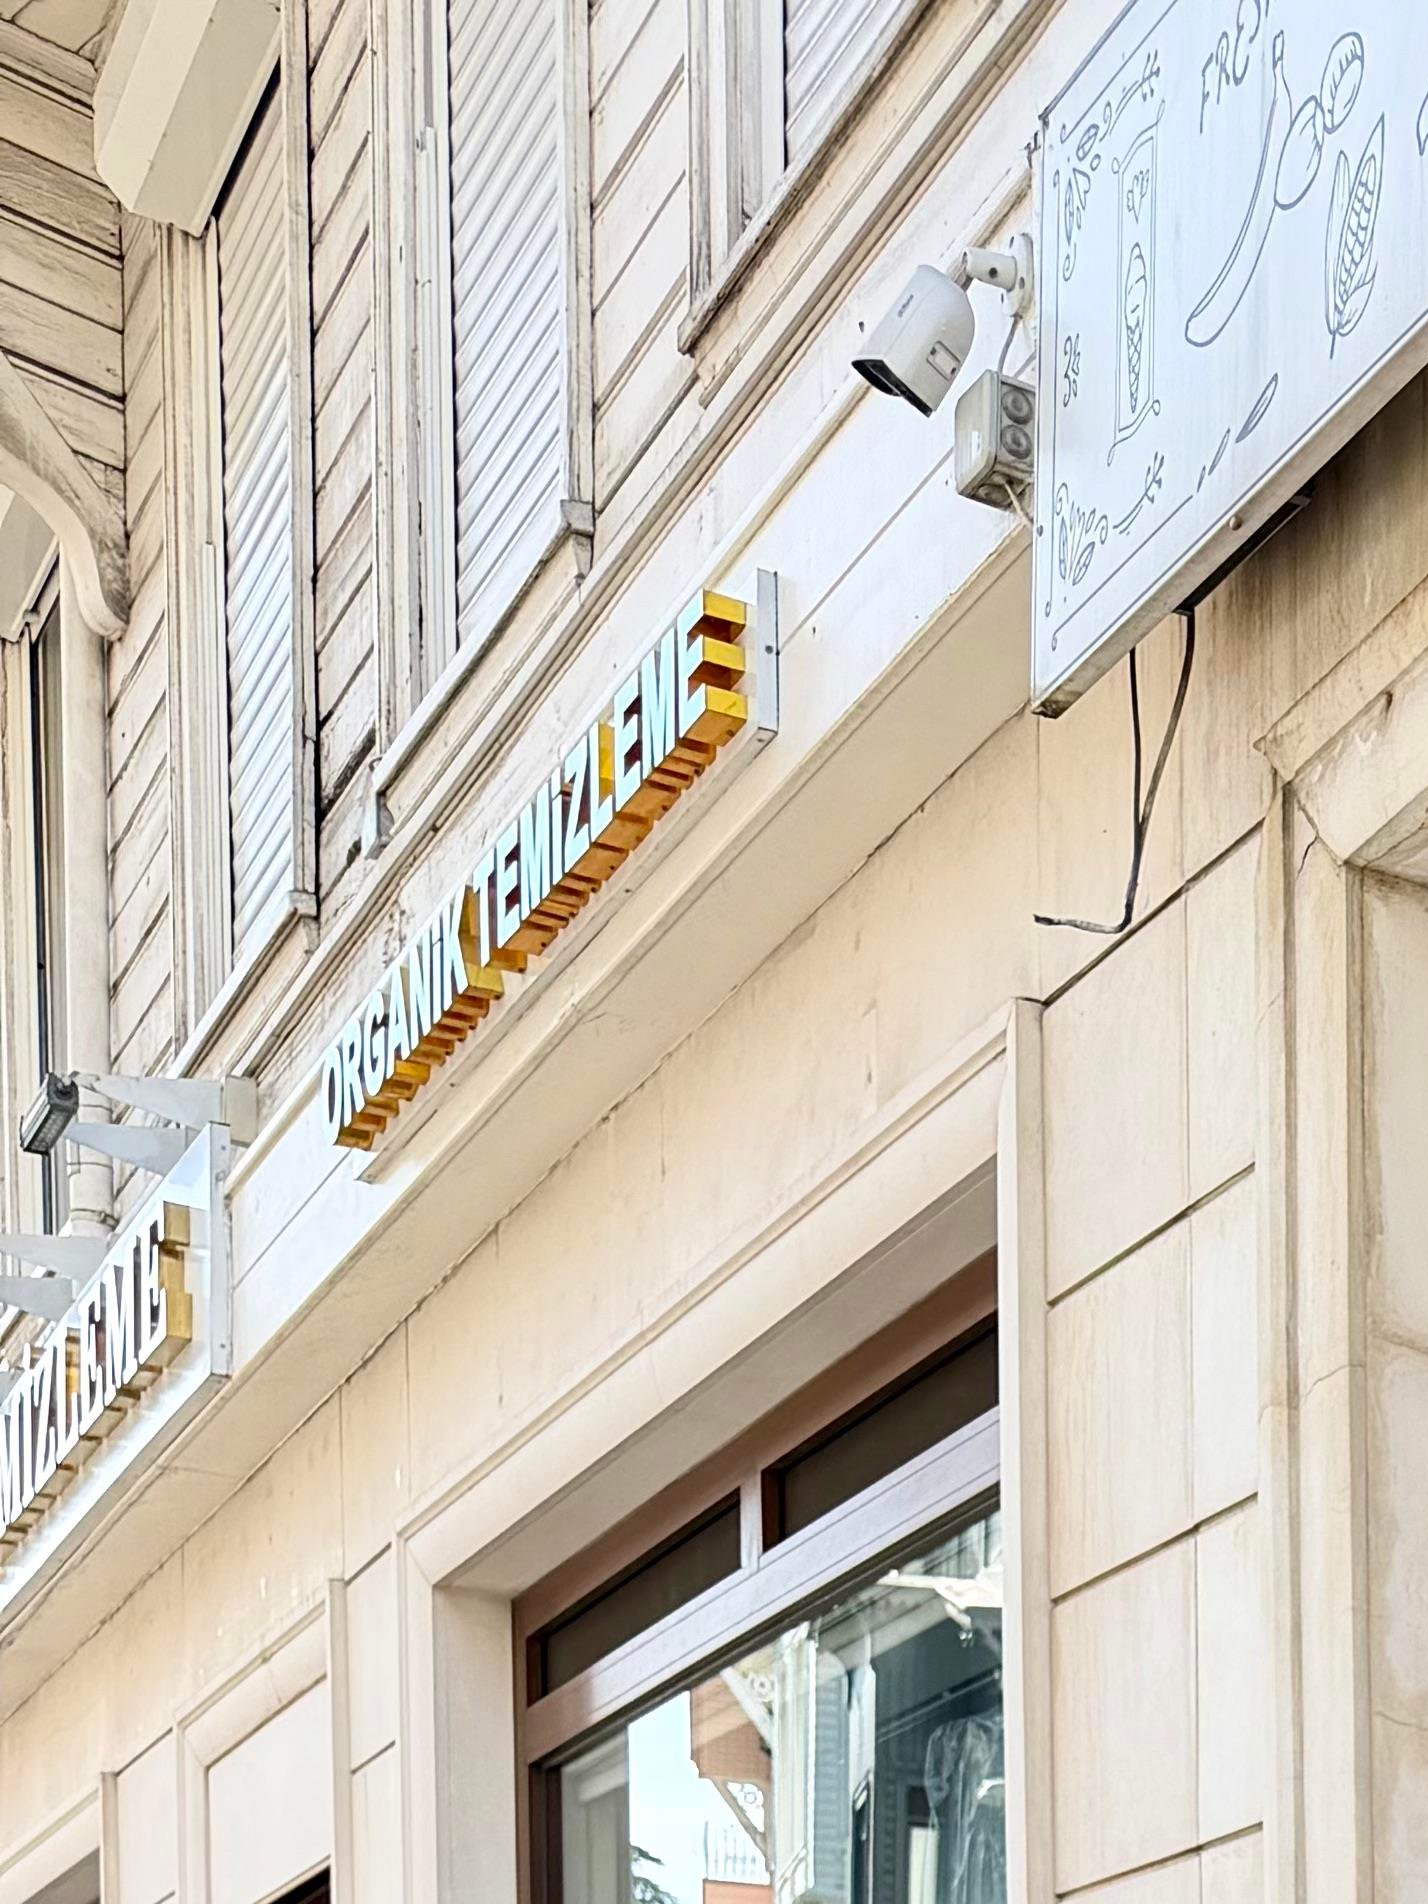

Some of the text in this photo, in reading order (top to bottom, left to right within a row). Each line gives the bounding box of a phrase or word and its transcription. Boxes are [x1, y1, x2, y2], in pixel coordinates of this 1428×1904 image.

[321, 588, 708, 1146] ORGANİK TEMİZLEME
[0, 1200, 168, 1540] MİZLEME
